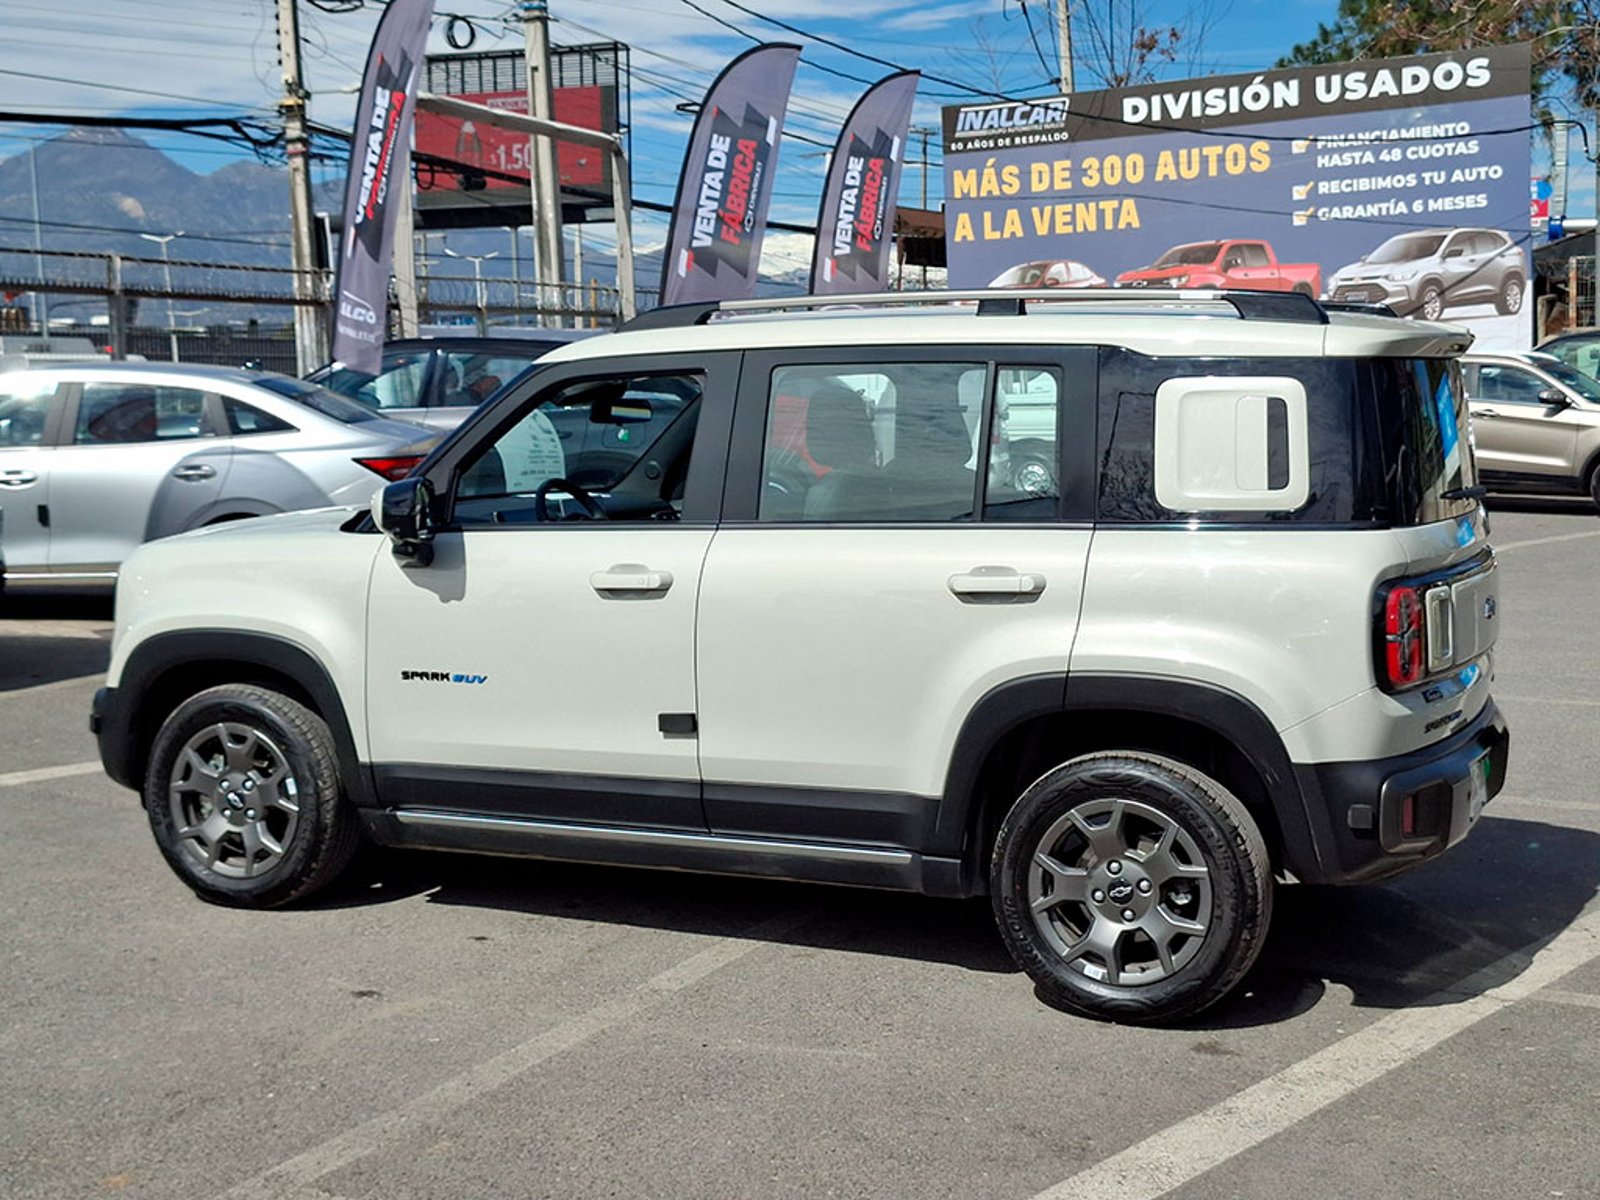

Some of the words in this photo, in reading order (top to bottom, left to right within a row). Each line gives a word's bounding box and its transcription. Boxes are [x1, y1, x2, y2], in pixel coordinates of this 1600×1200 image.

[1122, 76, 1300, 124] DIVISIÓN
[1314, 57, 1492, 103] USADOS
[956, 102, 1066, 132] INALCAR
[1316, 122, 1470, 149] FINANCIAMIENTO
[355, 132, 383, 224] VENTA
[371, 86, 390, 128] DE
[966, 138, 995, 150] AÑOS
[997, 138, 1011, 148] DE
[1014, 132, 1069, 146] RESPALDO
[1316, 151, 1375, 168] HASTA
[1379, 148, 1402, 162] 48
[1406, 140, 1480, 160] CUOTAS
[691, 172, 724, 248] VENTA
[711, 134, 731, 169] DE
[953, 158, 1021, 198] MÁS
[1031, 160, 1072, 192] DE
[1081, 153, 1144, 188] 300
[1154, 141, 1270, 182] AUTOS
[1318, 174, 1418, 195] RECIBIMOS
[1422, 171, 1446, 186] TU
[1451, 165, 1503, 183] AUTO
[717, 138, 758, 245] FÁBRICA
[834, 185, 859, 256] VENTA
[847, 156, 864, 184] DE
[853, 158, 884, 252] FÁBRICA
[1317, 199, 1408, 222] GARANTÍA
[1412, 200, 1424, 214] 6
[1428, 194, 1488, 211] MESES
[954, 213, 975, 242] A
[984, 209, 1024, 240] LA
[1031, 199, 1141, 236] VENTA
[401, 670, 450, 682] SPARK
